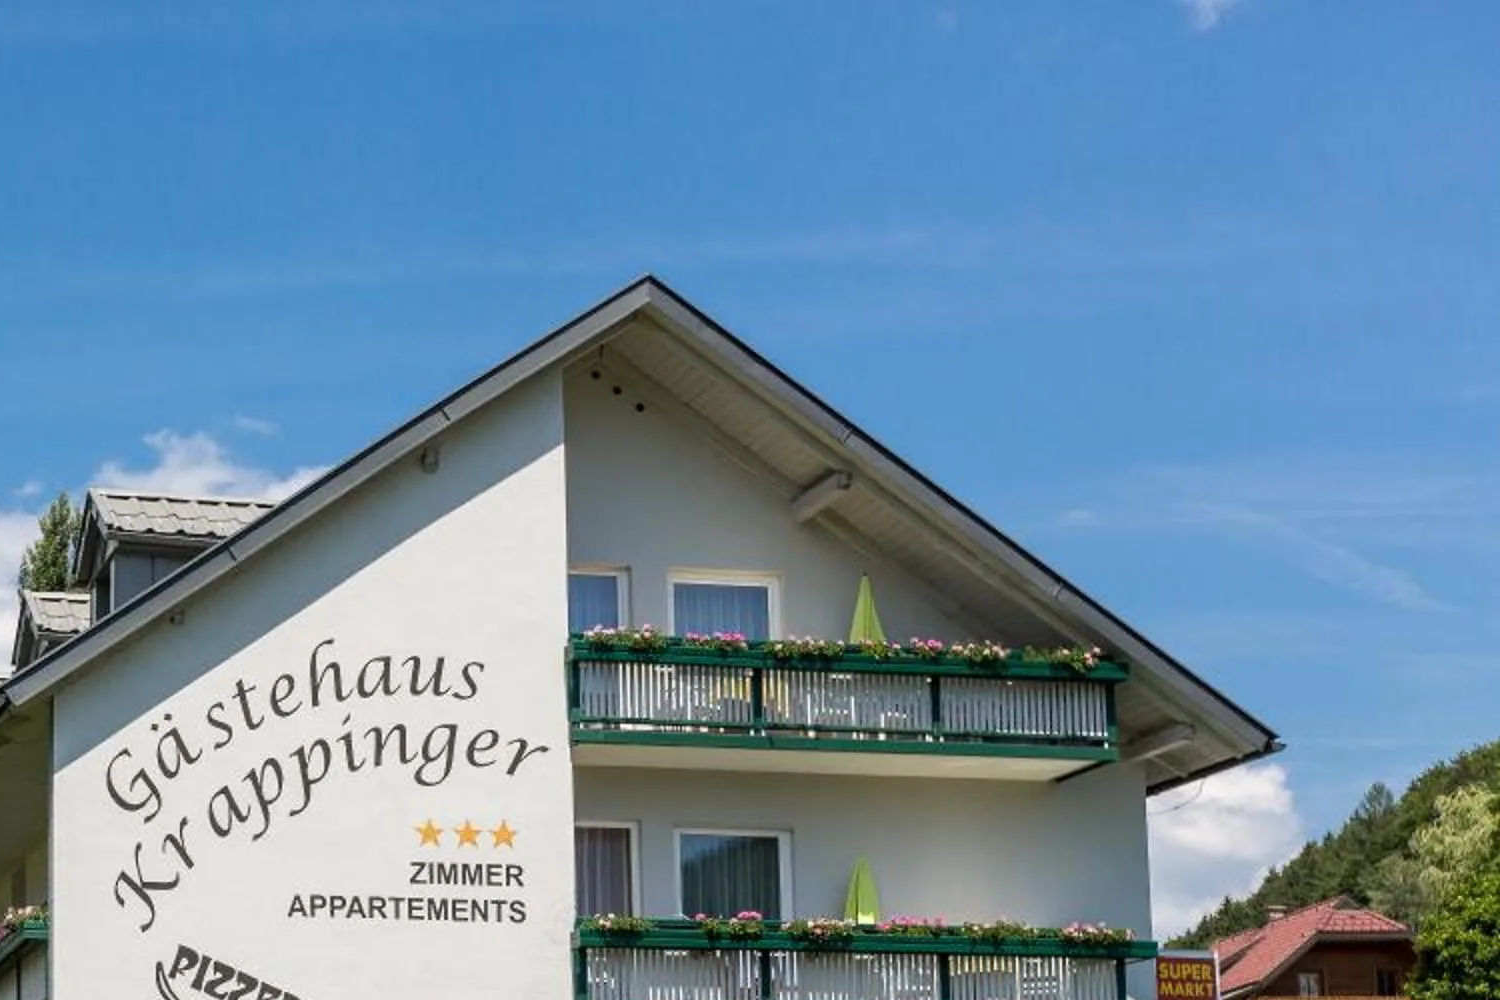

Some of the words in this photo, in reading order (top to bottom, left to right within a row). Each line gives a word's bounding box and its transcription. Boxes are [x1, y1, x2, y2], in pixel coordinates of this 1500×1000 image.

[106, 639, 485, 823] Gästehaus
[114, 714, 549, 932] Krappinger
[410, 862, 524, 886] ZIMMER
[288, 895, 527, 923] APPARTEMENTS
[1159, 962, 1212, 980] SUPER
[1160, 982, 1213, 996] MARKT
